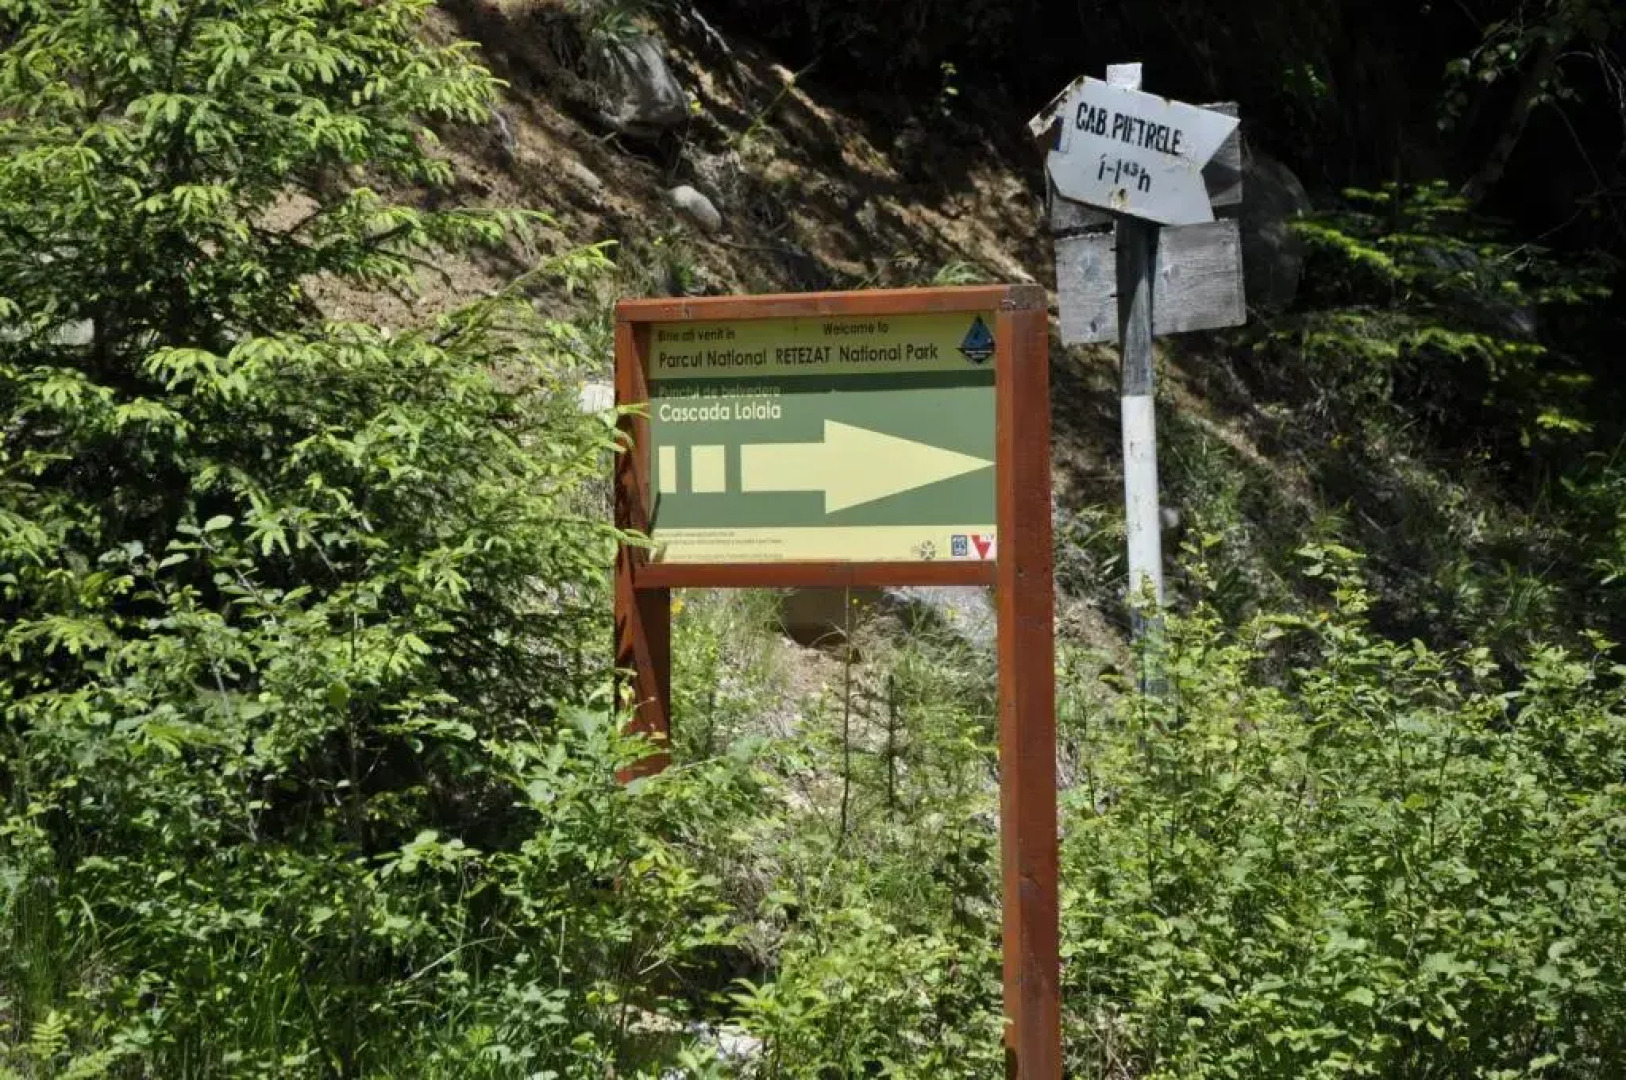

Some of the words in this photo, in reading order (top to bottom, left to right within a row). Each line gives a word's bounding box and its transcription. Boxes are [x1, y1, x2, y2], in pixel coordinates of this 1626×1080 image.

[1076, 101, 1109, 138] CAB.
[1112, 112, 1183, 156] PIETRELE
[698, 327, 724, 341] venit
[823, 322, 874, 336] Welcome
[876, 321, 889, 333] to
[659, 350, 703, 368] Parcul
[776, 345, 832, 364] RETEZAT
[839, 343, 901, 362] National
[906, 342, 938, 361] Park
[703, 384, 718, 398] de
[658, 402, 730, 422] Cascada
[734, 400, 781, 420] Lolaia
